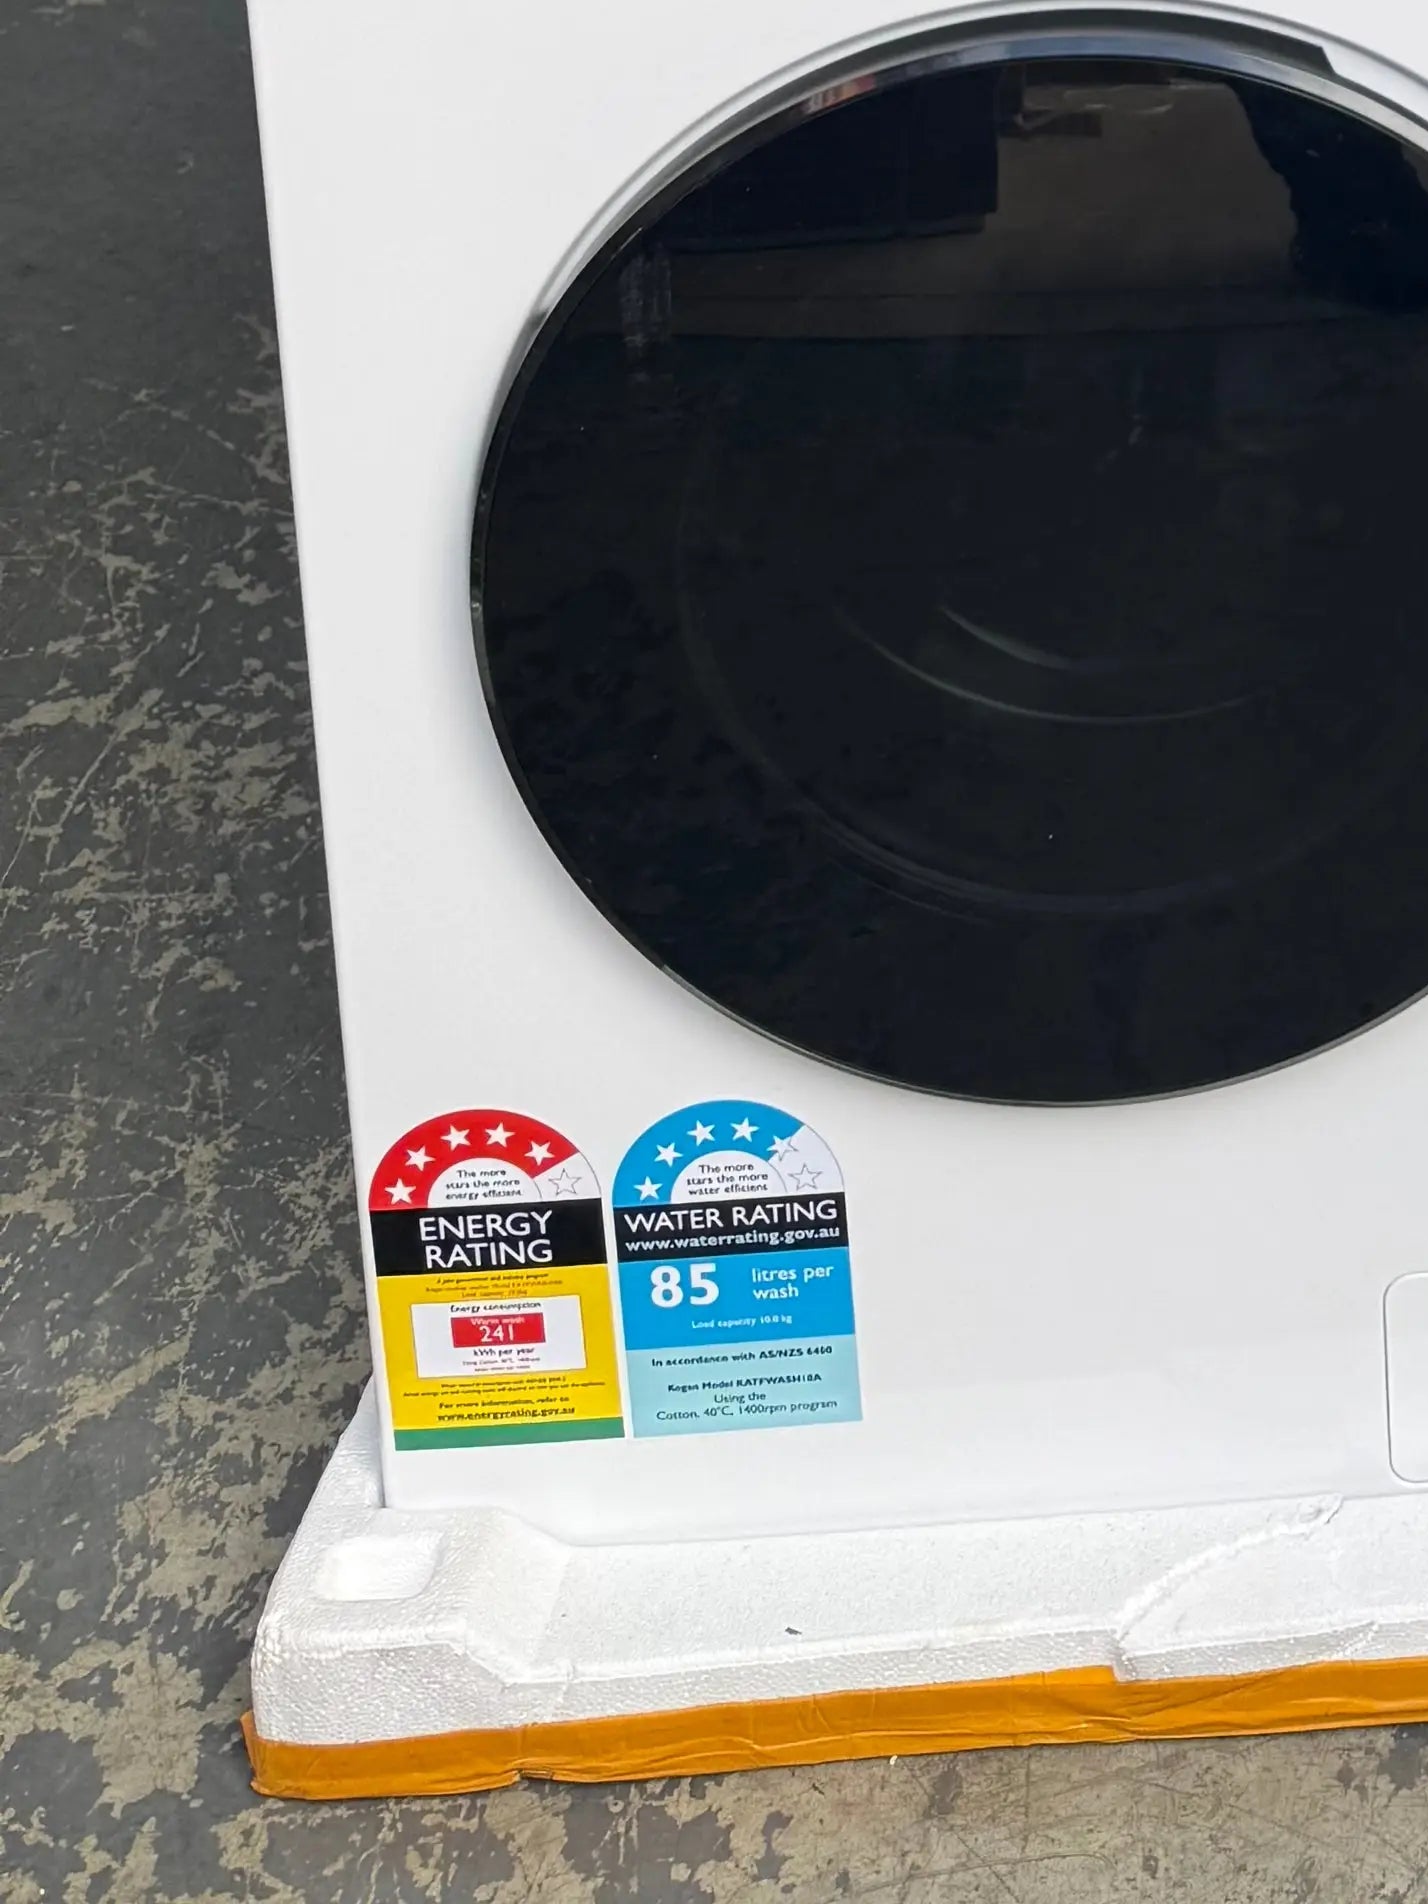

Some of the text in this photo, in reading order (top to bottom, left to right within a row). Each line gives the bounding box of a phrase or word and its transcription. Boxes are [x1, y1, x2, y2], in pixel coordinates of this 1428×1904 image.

[456, 1168, 507, 1179] The more
[698, 1163, 754, 1174] The more
[473, 1179, 491, 1189] the
[493, 1179, 521, 1187] more
[686, 1173, 769, 1186] stars the more
[445, 1191, 479, 1201] energy
[688, 1182, 769, 1196] water efficient
[623, 1199, 839, 1233] WATER RATING
[418, 1209, 553, 1242] ENERGY
[625, 1226, 841, 1252] www.waterrating.gov.au
[425, 1238, 553, 1270] RATING
[649, 1262, 835, 1309] 85 litres per
[752, 1283, 799, 1300] wash
[450, 1304, 481, 1314] Energy
[479, 1324, 514, 1343] 241
[473, 1348, 496, 1357] kWh
[498, 1348, 513, 1357] per
[651, 1358, 663, 1368] In
[665, 1354, 729, 1367] accordance
[731, 1352, 756, 1362] with
[758, 1348, 804, 1360] AS/NZS
[667, 1383, 700, 1394] Kogan
[702, 1380, 734, 1390] Model
[714, 1392, 767, 1404] Using the
[738, 1403, 787, 1416] 1400rpm
[790, 1399, 837, 1412] program
